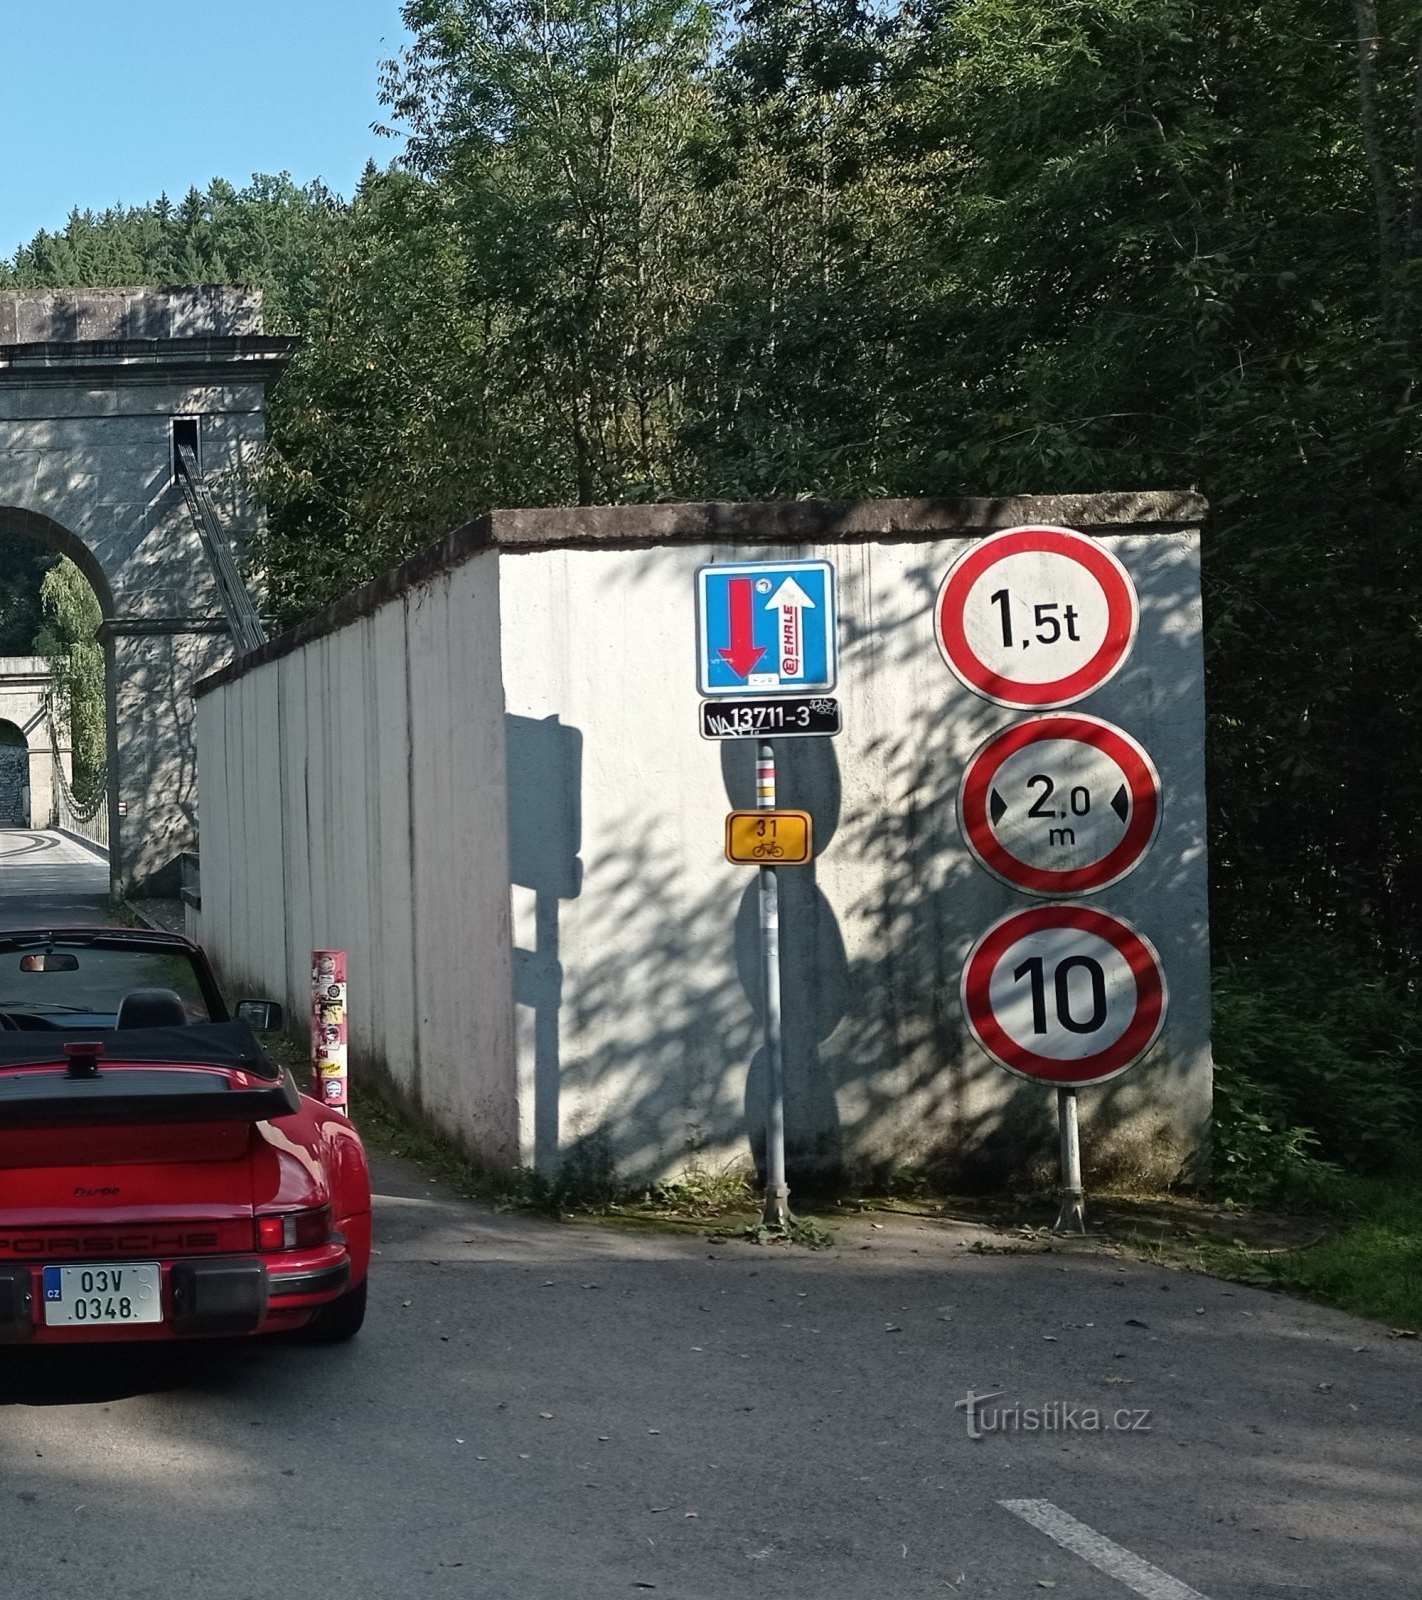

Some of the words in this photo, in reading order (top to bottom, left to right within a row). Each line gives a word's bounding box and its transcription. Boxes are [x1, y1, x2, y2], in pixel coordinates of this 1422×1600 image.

[783, 604, 794, 656] EHRLE
[730, 706, 811, 729] 13711-3
[1026, 774, 1091, 820] 2,0
[756, 819, 777, 837] 31
[1049, 828, 1076, 846] m
[1013, 955, 1107, 1035] 10
[81, 1269, 123, 1293] 03V
[47, 1288, 60, 1299] CZ
[75, 1296, 132, 1321] 0348
